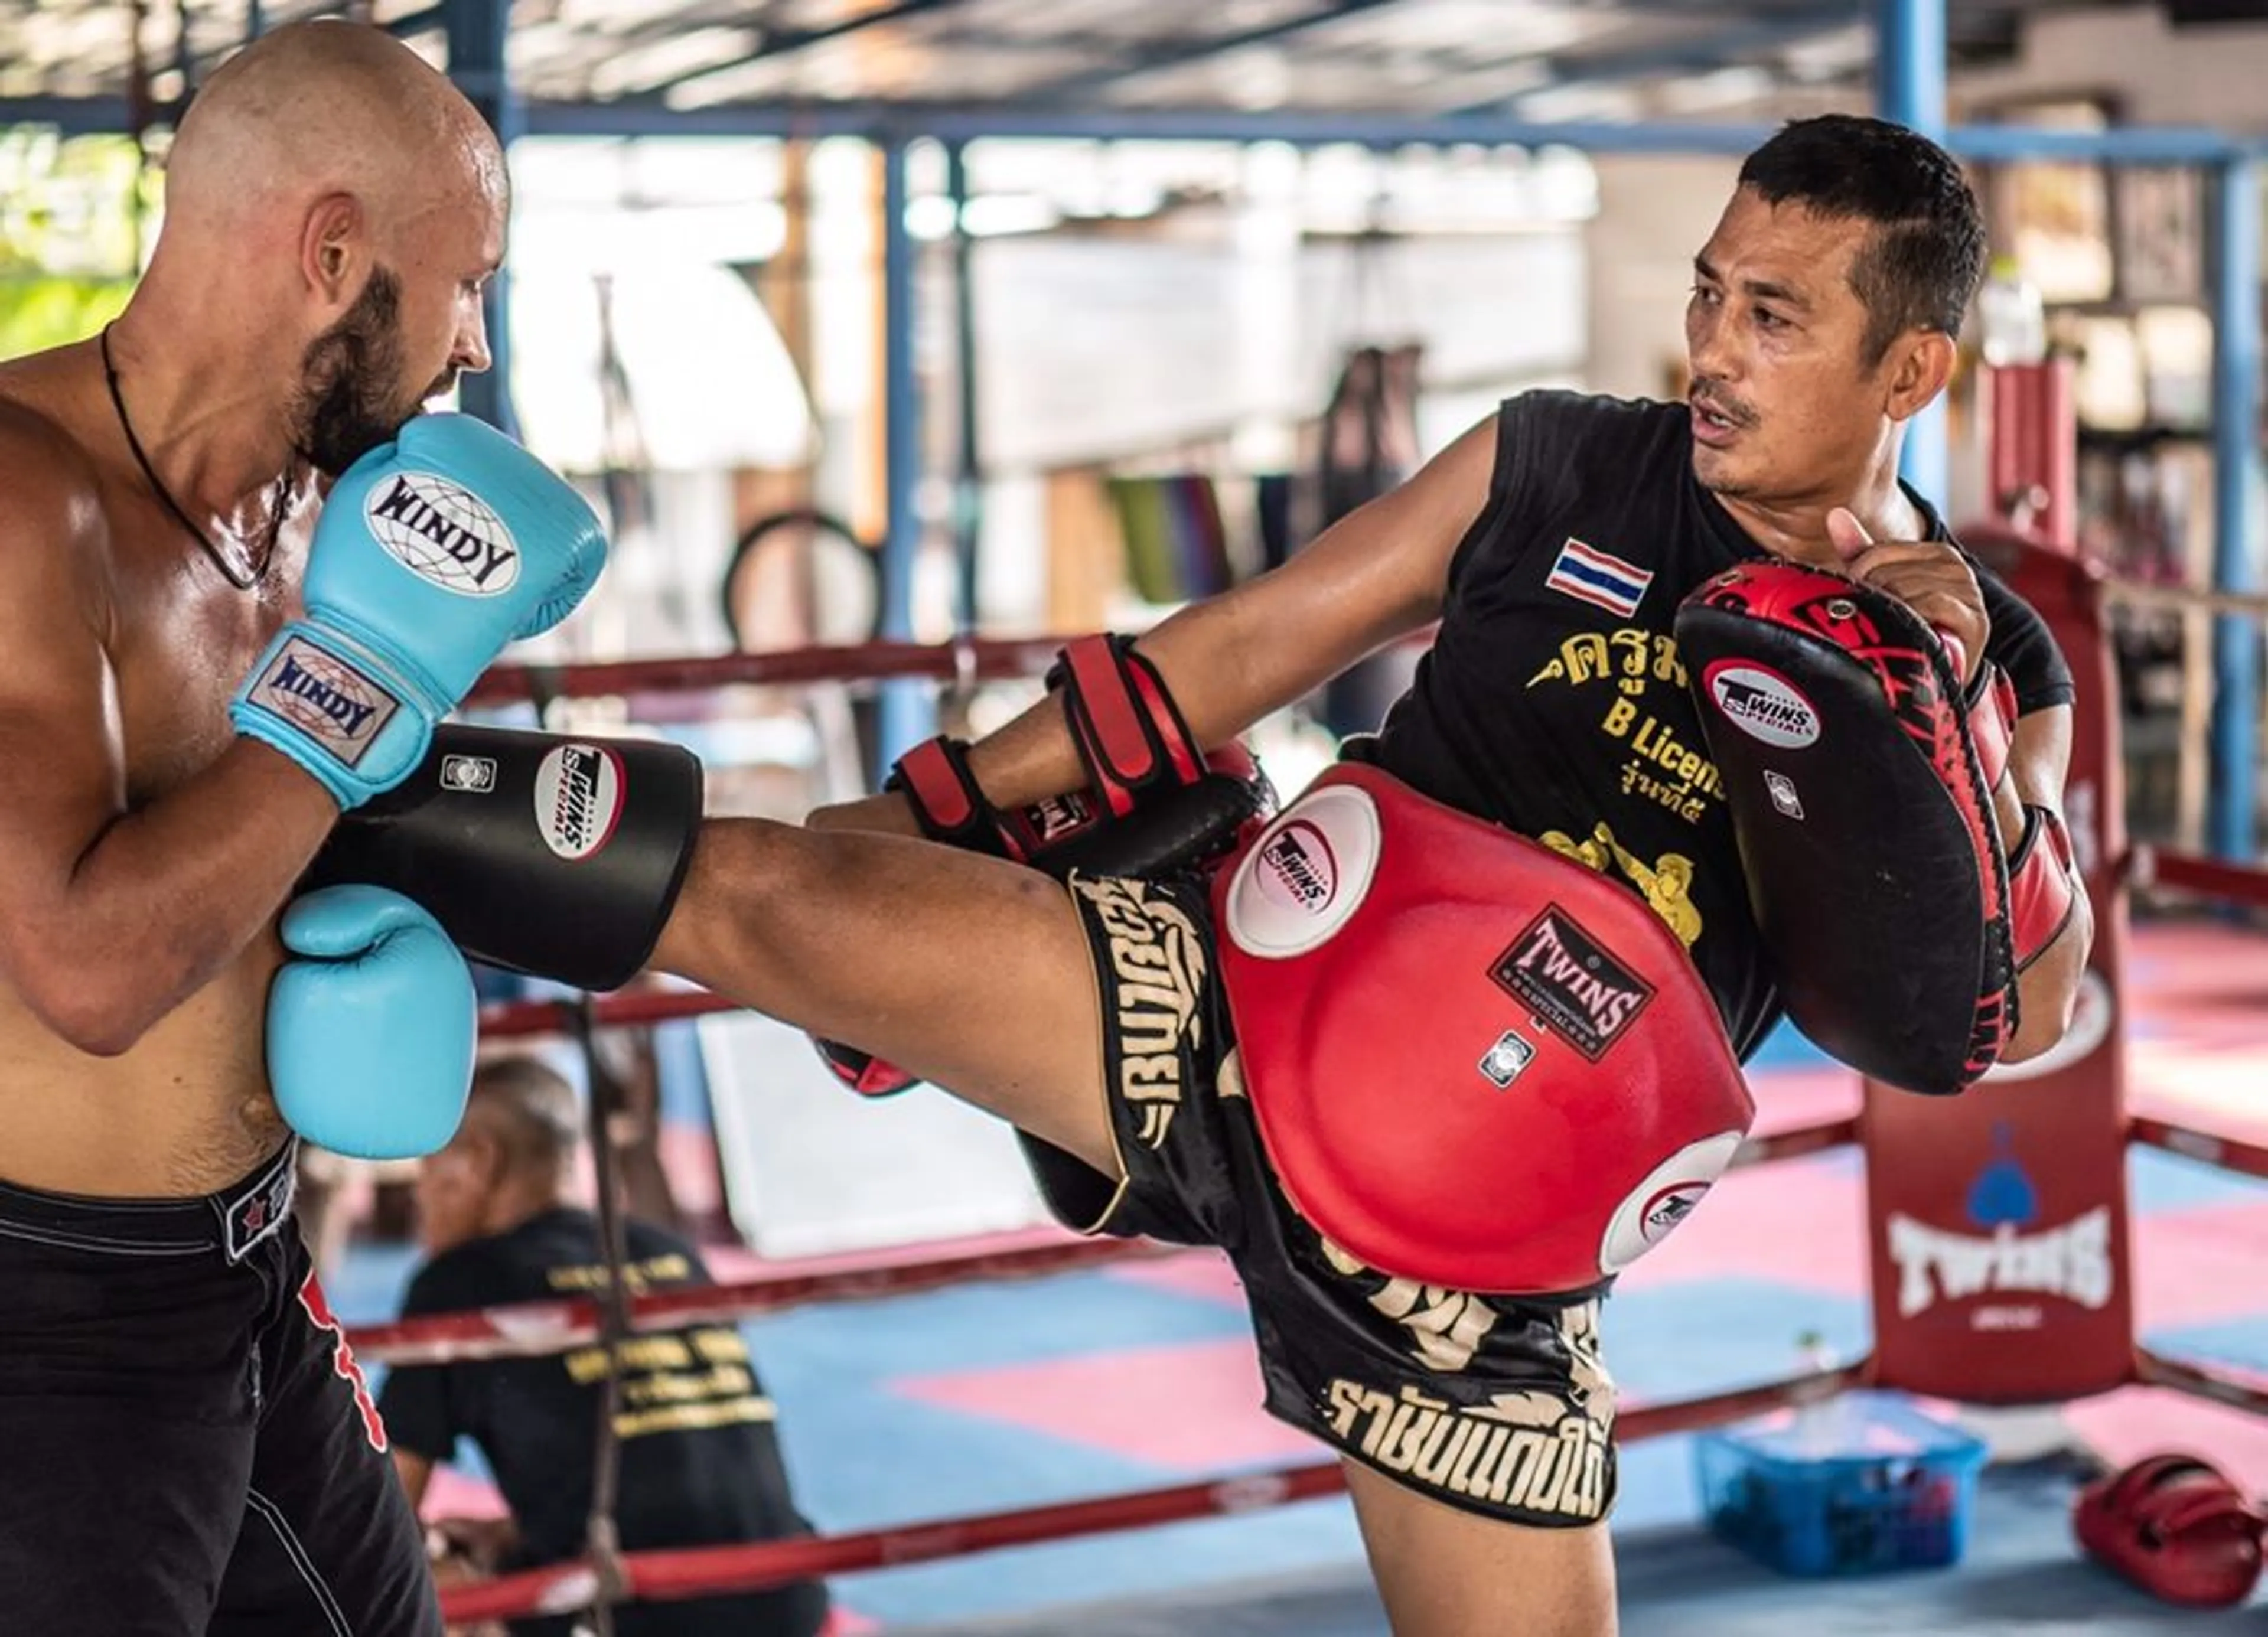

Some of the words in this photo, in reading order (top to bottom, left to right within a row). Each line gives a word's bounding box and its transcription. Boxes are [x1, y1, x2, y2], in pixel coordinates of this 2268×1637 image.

[371, 474, 516, 586] WINDY
[268, 654, 375, 736] WINDY
[1601, 696, 1637, 737] B
[1717, 676, 1811, 726] TWINS
[561, 745, 602, 850] TWINS
[1265, 830, 1327, 899] TWINS
[1514, 918, 1645, 1038] TWINS
[1887, 1203, 2114, 1320] TWINS
